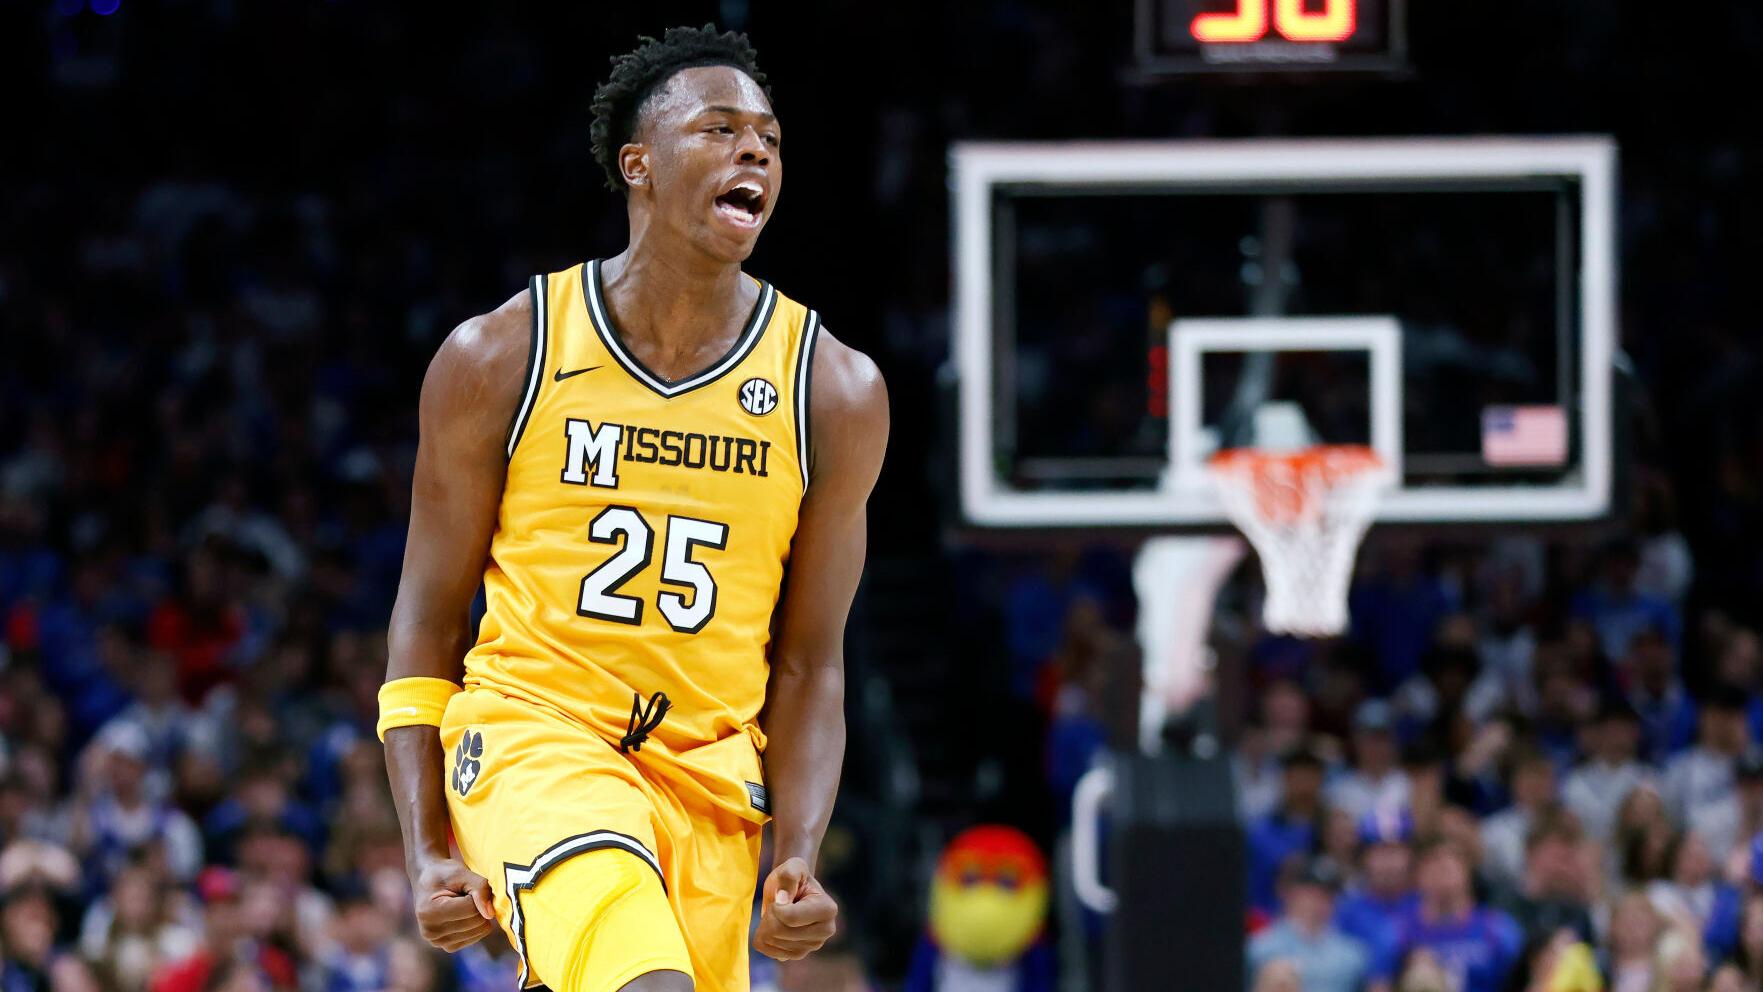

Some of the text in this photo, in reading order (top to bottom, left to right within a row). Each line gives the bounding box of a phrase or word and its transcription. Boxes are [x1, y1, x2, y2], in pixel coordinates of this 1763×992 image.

[741, 378, 777, 415] SEC
[560, 418, 771, 489] MISSOURI
[576, 504, 729, 634] 25
